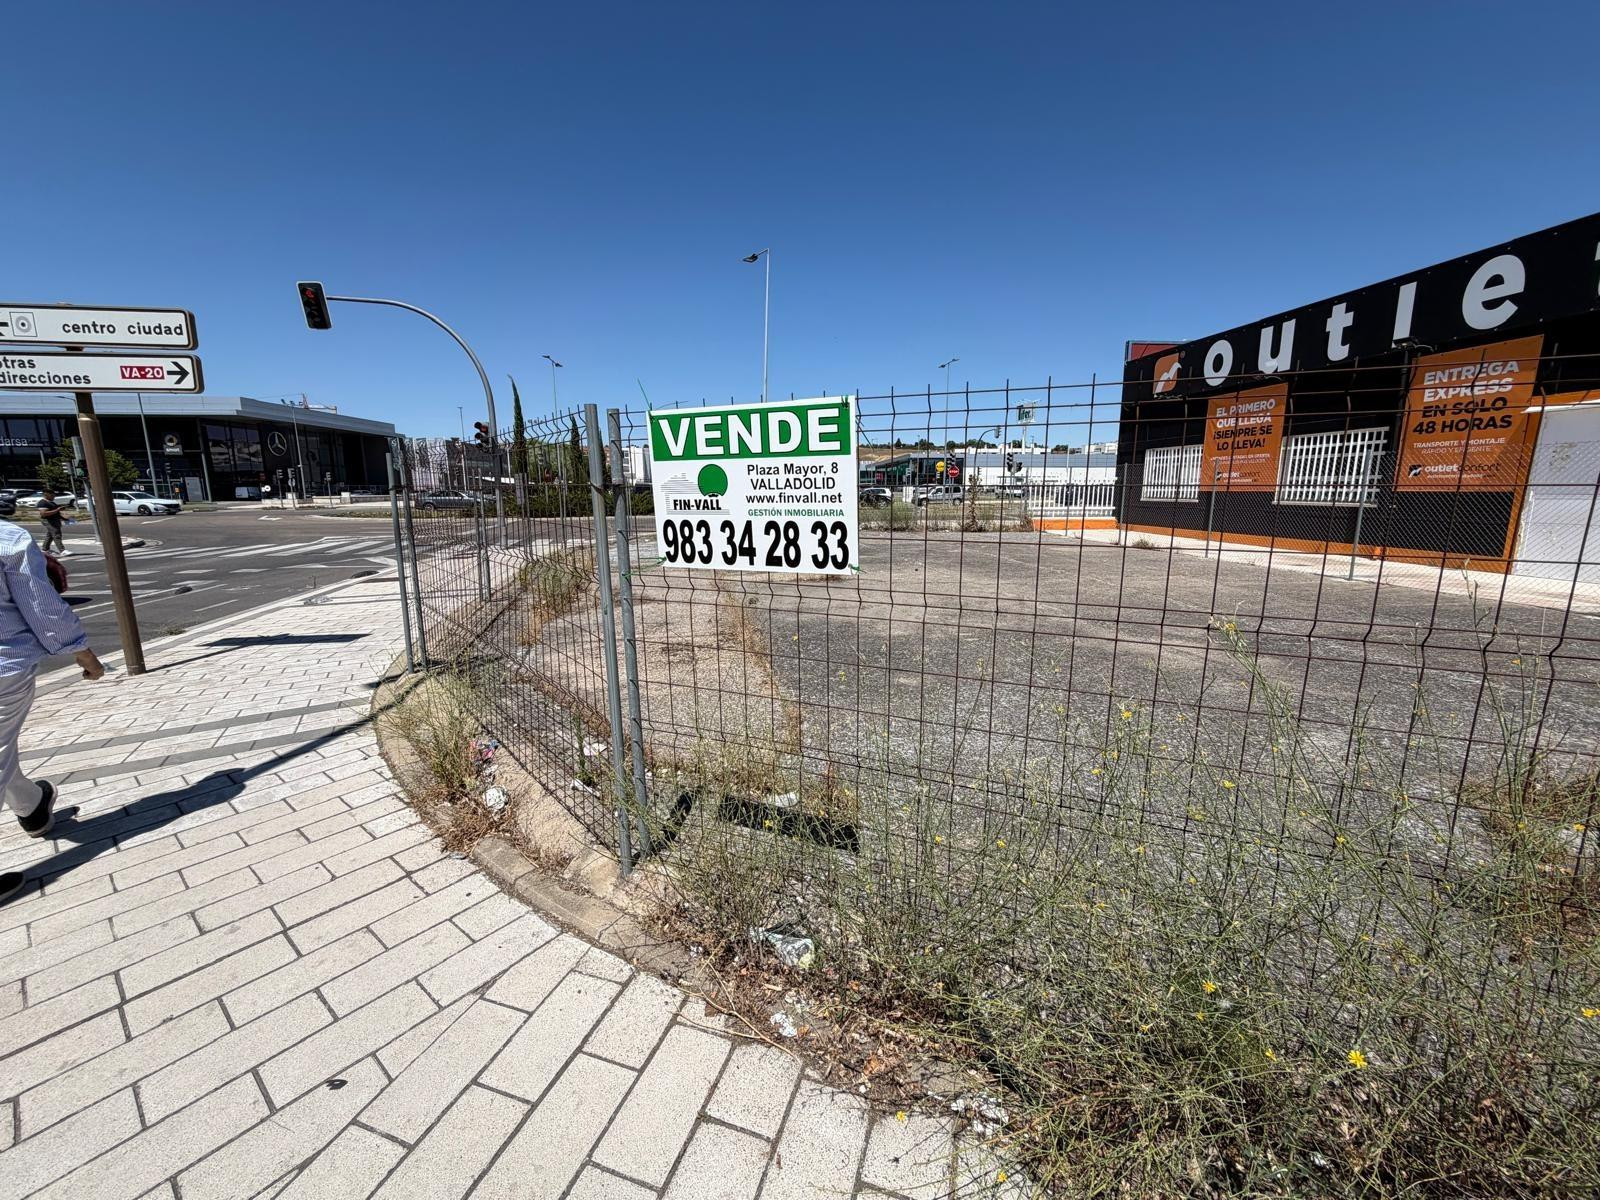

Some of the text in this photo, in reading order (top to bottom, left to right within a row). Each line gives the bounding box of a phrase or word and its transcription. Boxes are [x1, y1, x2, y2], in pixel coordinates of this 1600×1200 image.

[1203, 241, 1600, 387] outle
[62, 321, 184, 336] centro ciudad
[121, 367, 163, 379] VA-20
[1424, 360, 1519, 386] ENTREGA
[1424, 377, 1514, 402] EXPRESS
[1216, 399, 1276, 417] EL PRIMERO
[1422, 396, 1508, 418] EN SOLO
[1216, 412, 1272, 428] QUE LLEGA
[1413, 415, 1513, 435] 48 HORAS
[658, 407, 841, 457] VENDE
[1259, 425, 1273, 435] SE
[1216, 441, 1229, 451] LO
[1413, 440, 1459, 449] TRANSPORTE
[747, 462, 839, 477] Plaza Mayor, 8
[750, 477, 836, 490] VALLADOLID
[673, 499, 722, 511] FIN-VALL
[745, 492, 843, 503] www.finvall.net
[747, 507, 845, 517] GESTIÓN INMOBILIARIA
[662, 519, 849, 570] 983 34 28 33
